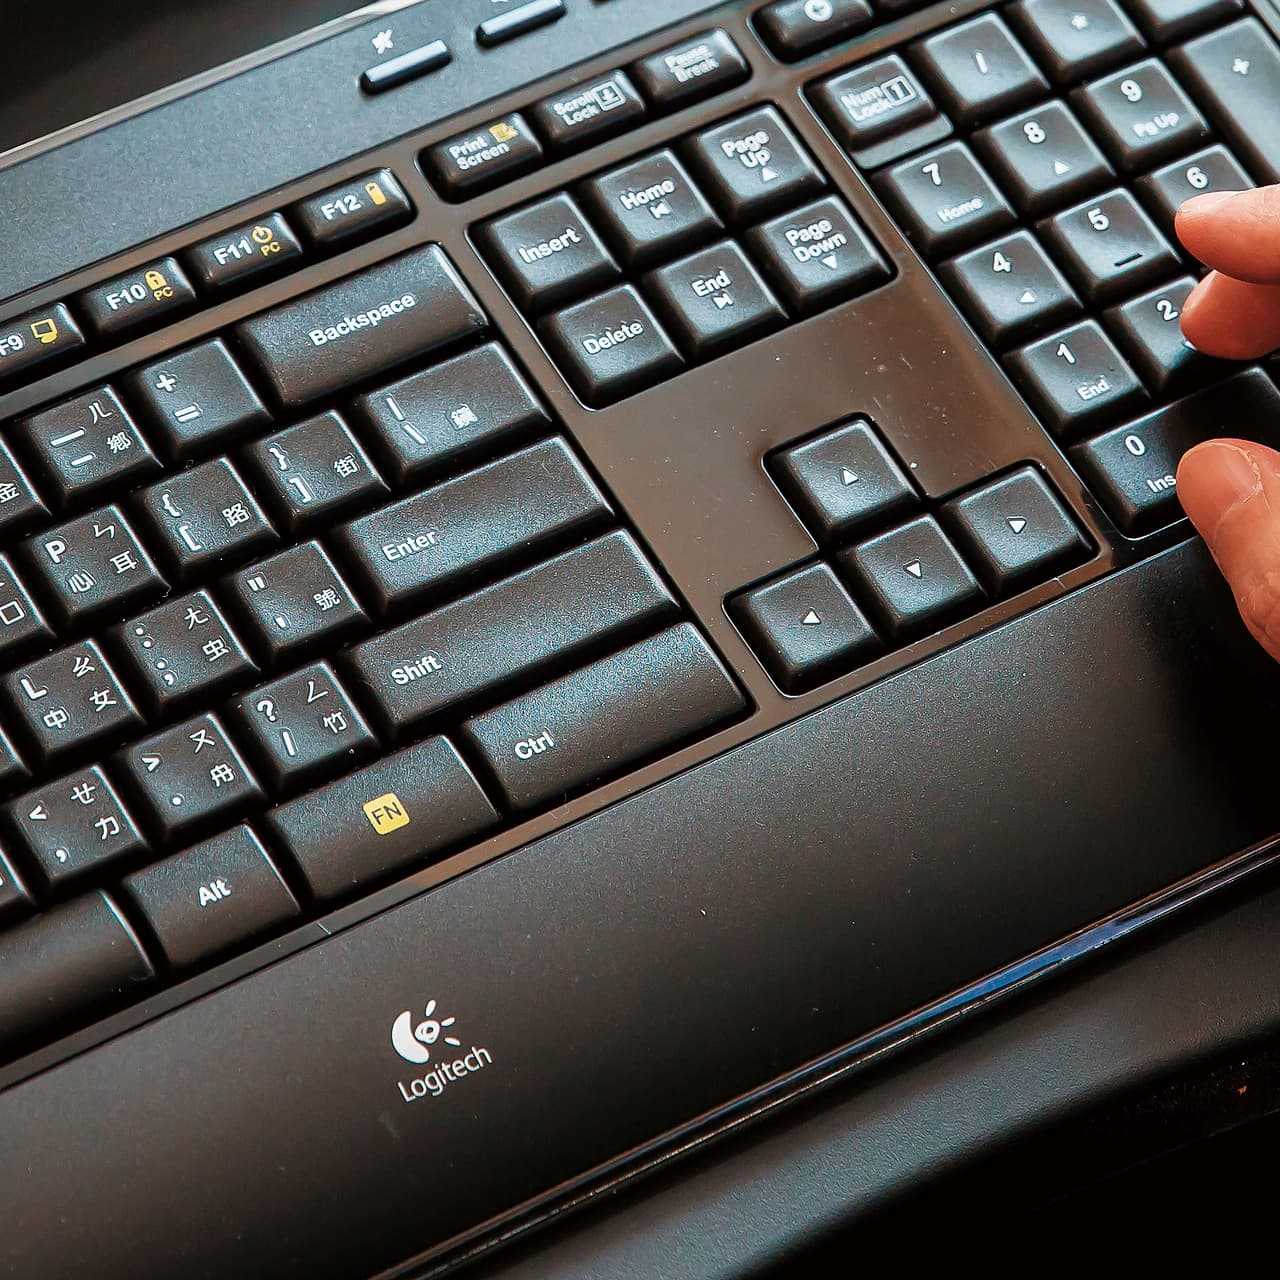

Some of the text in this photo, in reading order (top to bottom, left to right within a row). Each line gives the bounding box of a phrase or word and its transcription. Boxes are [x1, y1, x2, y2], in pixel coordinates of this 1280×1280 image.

[664, 43, 710, 71] Pause
[672, 57, 719, 85] Break
[553, 89, 596, 117] Scroll
[841, 84, 882, 112] Num
[1119, 80, 1144, 103] 9
[562, 103, 600, 127] Lock
[847, 97, 888, 123] Lock
[721, 129, 770, 160] Page
[1022, 121, 1047, 144] 8
[448, 134, 488, 160] Print
[455, 139, 511, 171] Screen
[739, 147, 771, 170] Up
[923, 162, 946, 186] 7
[619, 176, 675, 211] Home
[320, 194, 361, 222] F12
[937, 196, 984, 224] Home
[1088, 209, 1110, 231] 5
[518, 228, 582, 265] Insert
[785, 217, 834, 248] Page
[213, 238, 281, 266] F11 PC
[792, 232, 848, 264] Down
[992, 251, 1012, 274] 4
[106, 283, 174, 311] F10 PC
[691, 272, 732, 298] End
[308, 292, 416, 348] Backspace
[582, 320, 645, 356] Delete
[1076, 376, 1111, 401] End
[1124, 435, 1146, 458] 0
[1146, 473, 1176, 494] Ins
[44, 540, 67, 565] P
[381, 528, 439, 563] Enter
[390, 652, 443, 688] Shift
[21, 677, 48, 701] L
[513, 731, 554, 762] Ctrl
[371, 801, 401, 823] FN
[196, 878, 232, 907] Alt
[397, 1044, 493, 1103] Logitech
